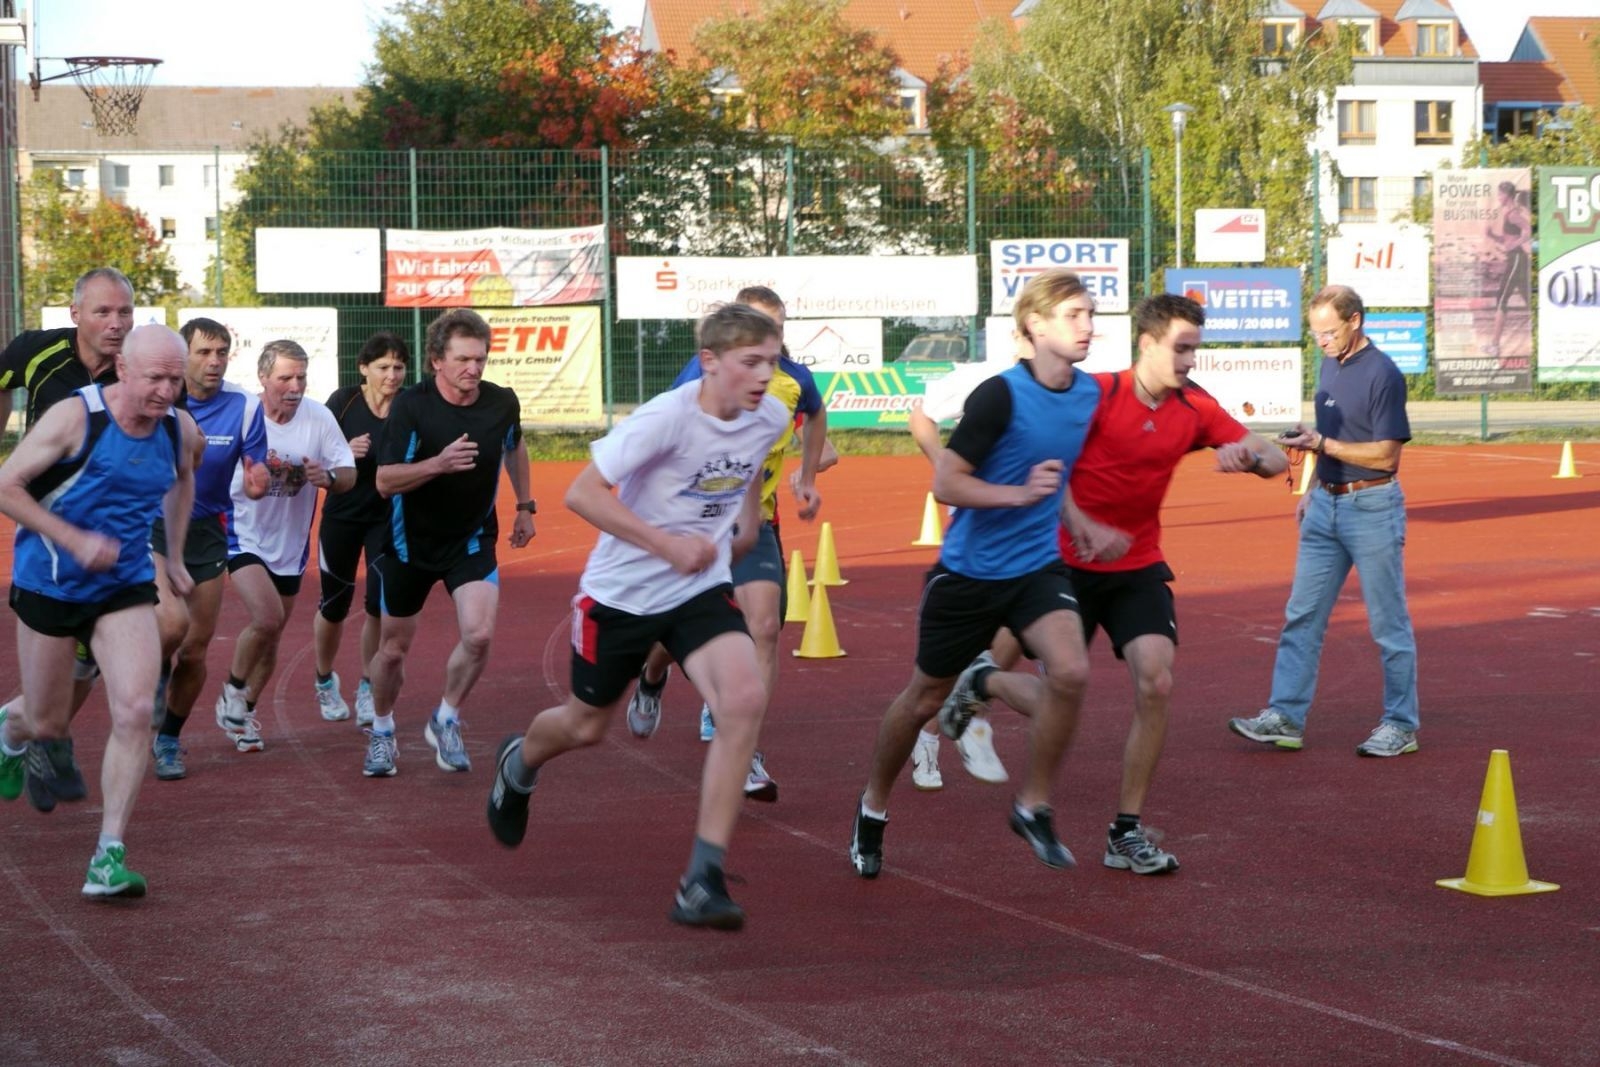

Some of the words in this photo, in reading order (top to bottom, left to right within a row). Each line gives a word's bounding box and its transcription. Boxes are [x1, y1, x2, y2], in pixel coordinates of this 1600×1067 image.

[1439, 183, 1492, 198] POWER
[1443, 208, 1499, 221] BUSINESS
[1001, 243, 1119, 266] SPORT
[395, 259, 430, 275] Wir
[432, 257, 490, 275] fahren
[395, 282, 425, 296] zur
[687, 274, 776, 292] Sparkasse
[1001, 275, 1119, 298] VER
[1210, 289, 1289, 309] VETTER
[488, 315, 571, 324] Elektro-Technik
[489, 325, 570, 353] ETN
[487, 357, 522, 366] iesky
[525, 356, 562, 365] GmbH
[843, 354, 871, 365] AG
[1193, 355, 1293, 372] illkommen
[830, 393, 925, 410] Zimmere
